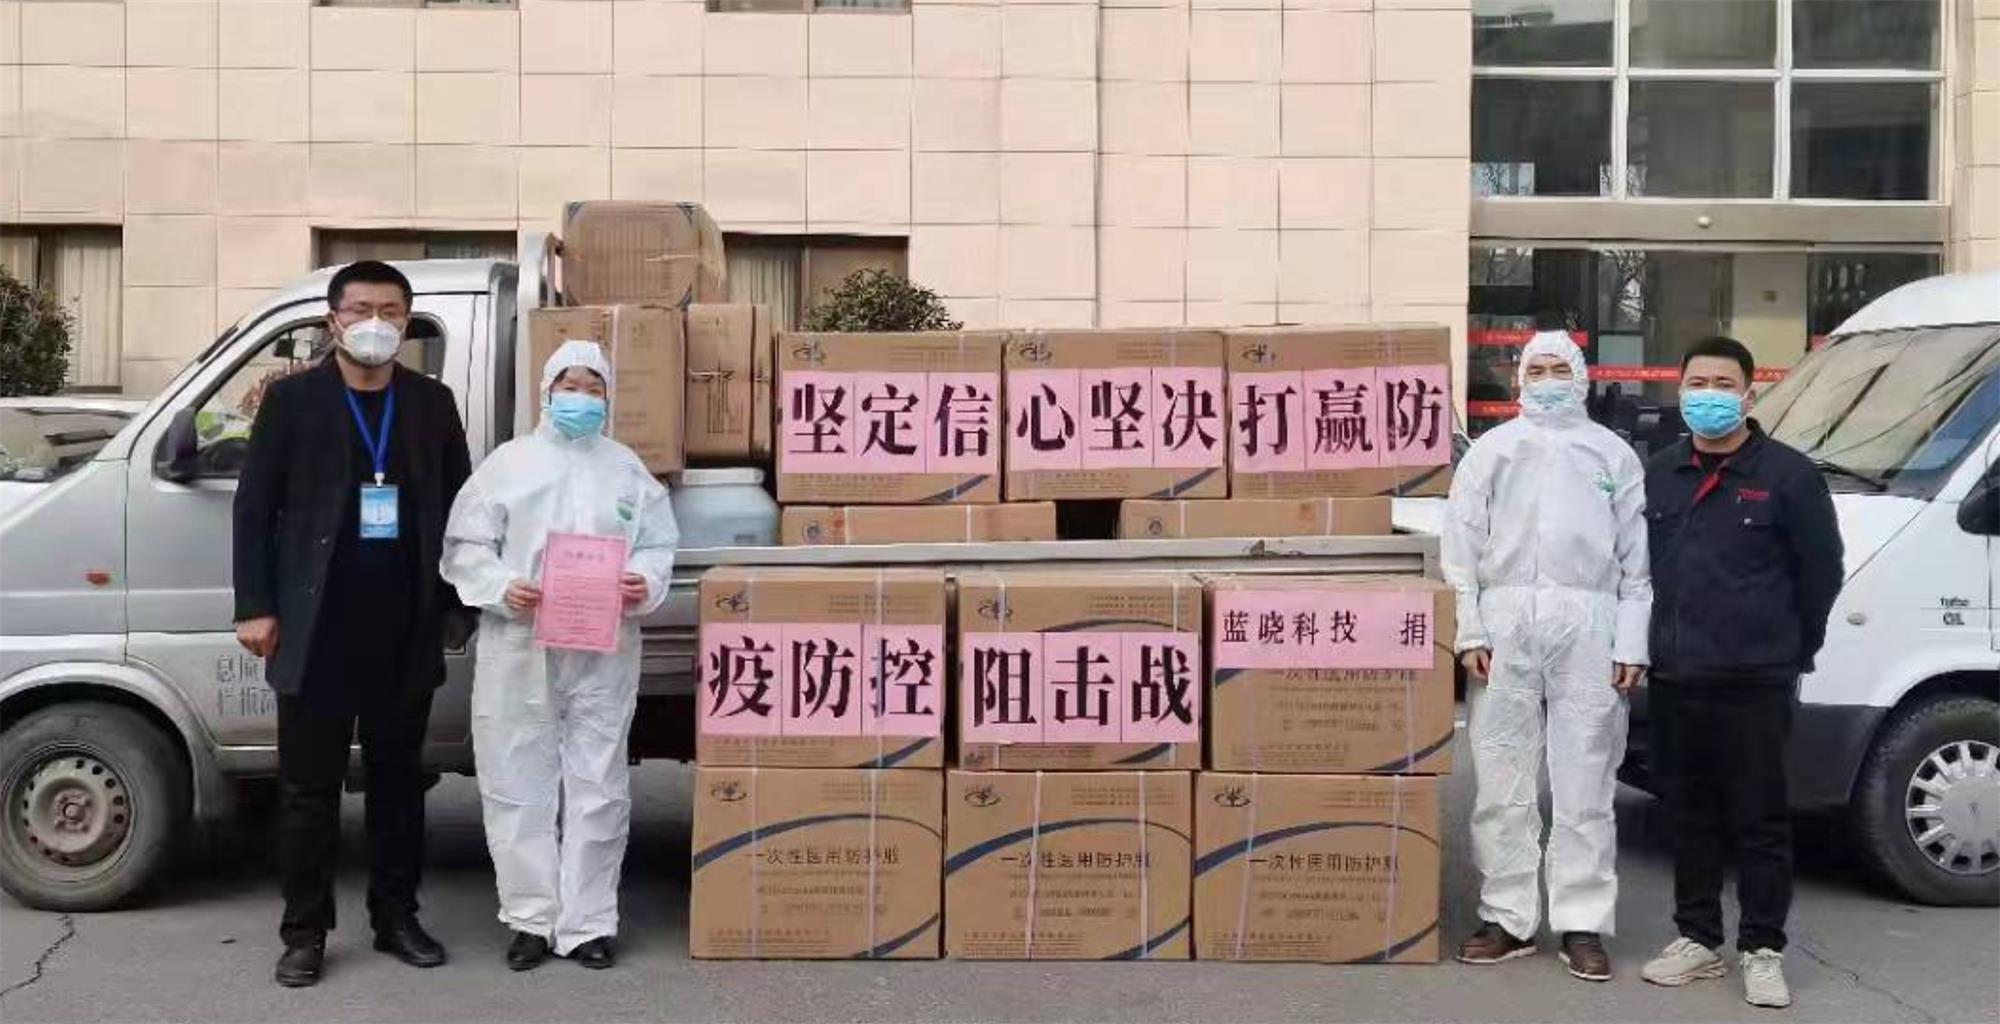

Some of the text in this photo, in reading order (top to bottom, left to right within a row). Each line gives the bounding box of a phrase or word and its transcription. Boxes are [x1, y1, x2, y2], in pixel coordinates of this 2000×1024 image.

[1222, 609, 1427, 646] 蓝晓科技 捐
[974, 644, 1193, 728] 阻击战
